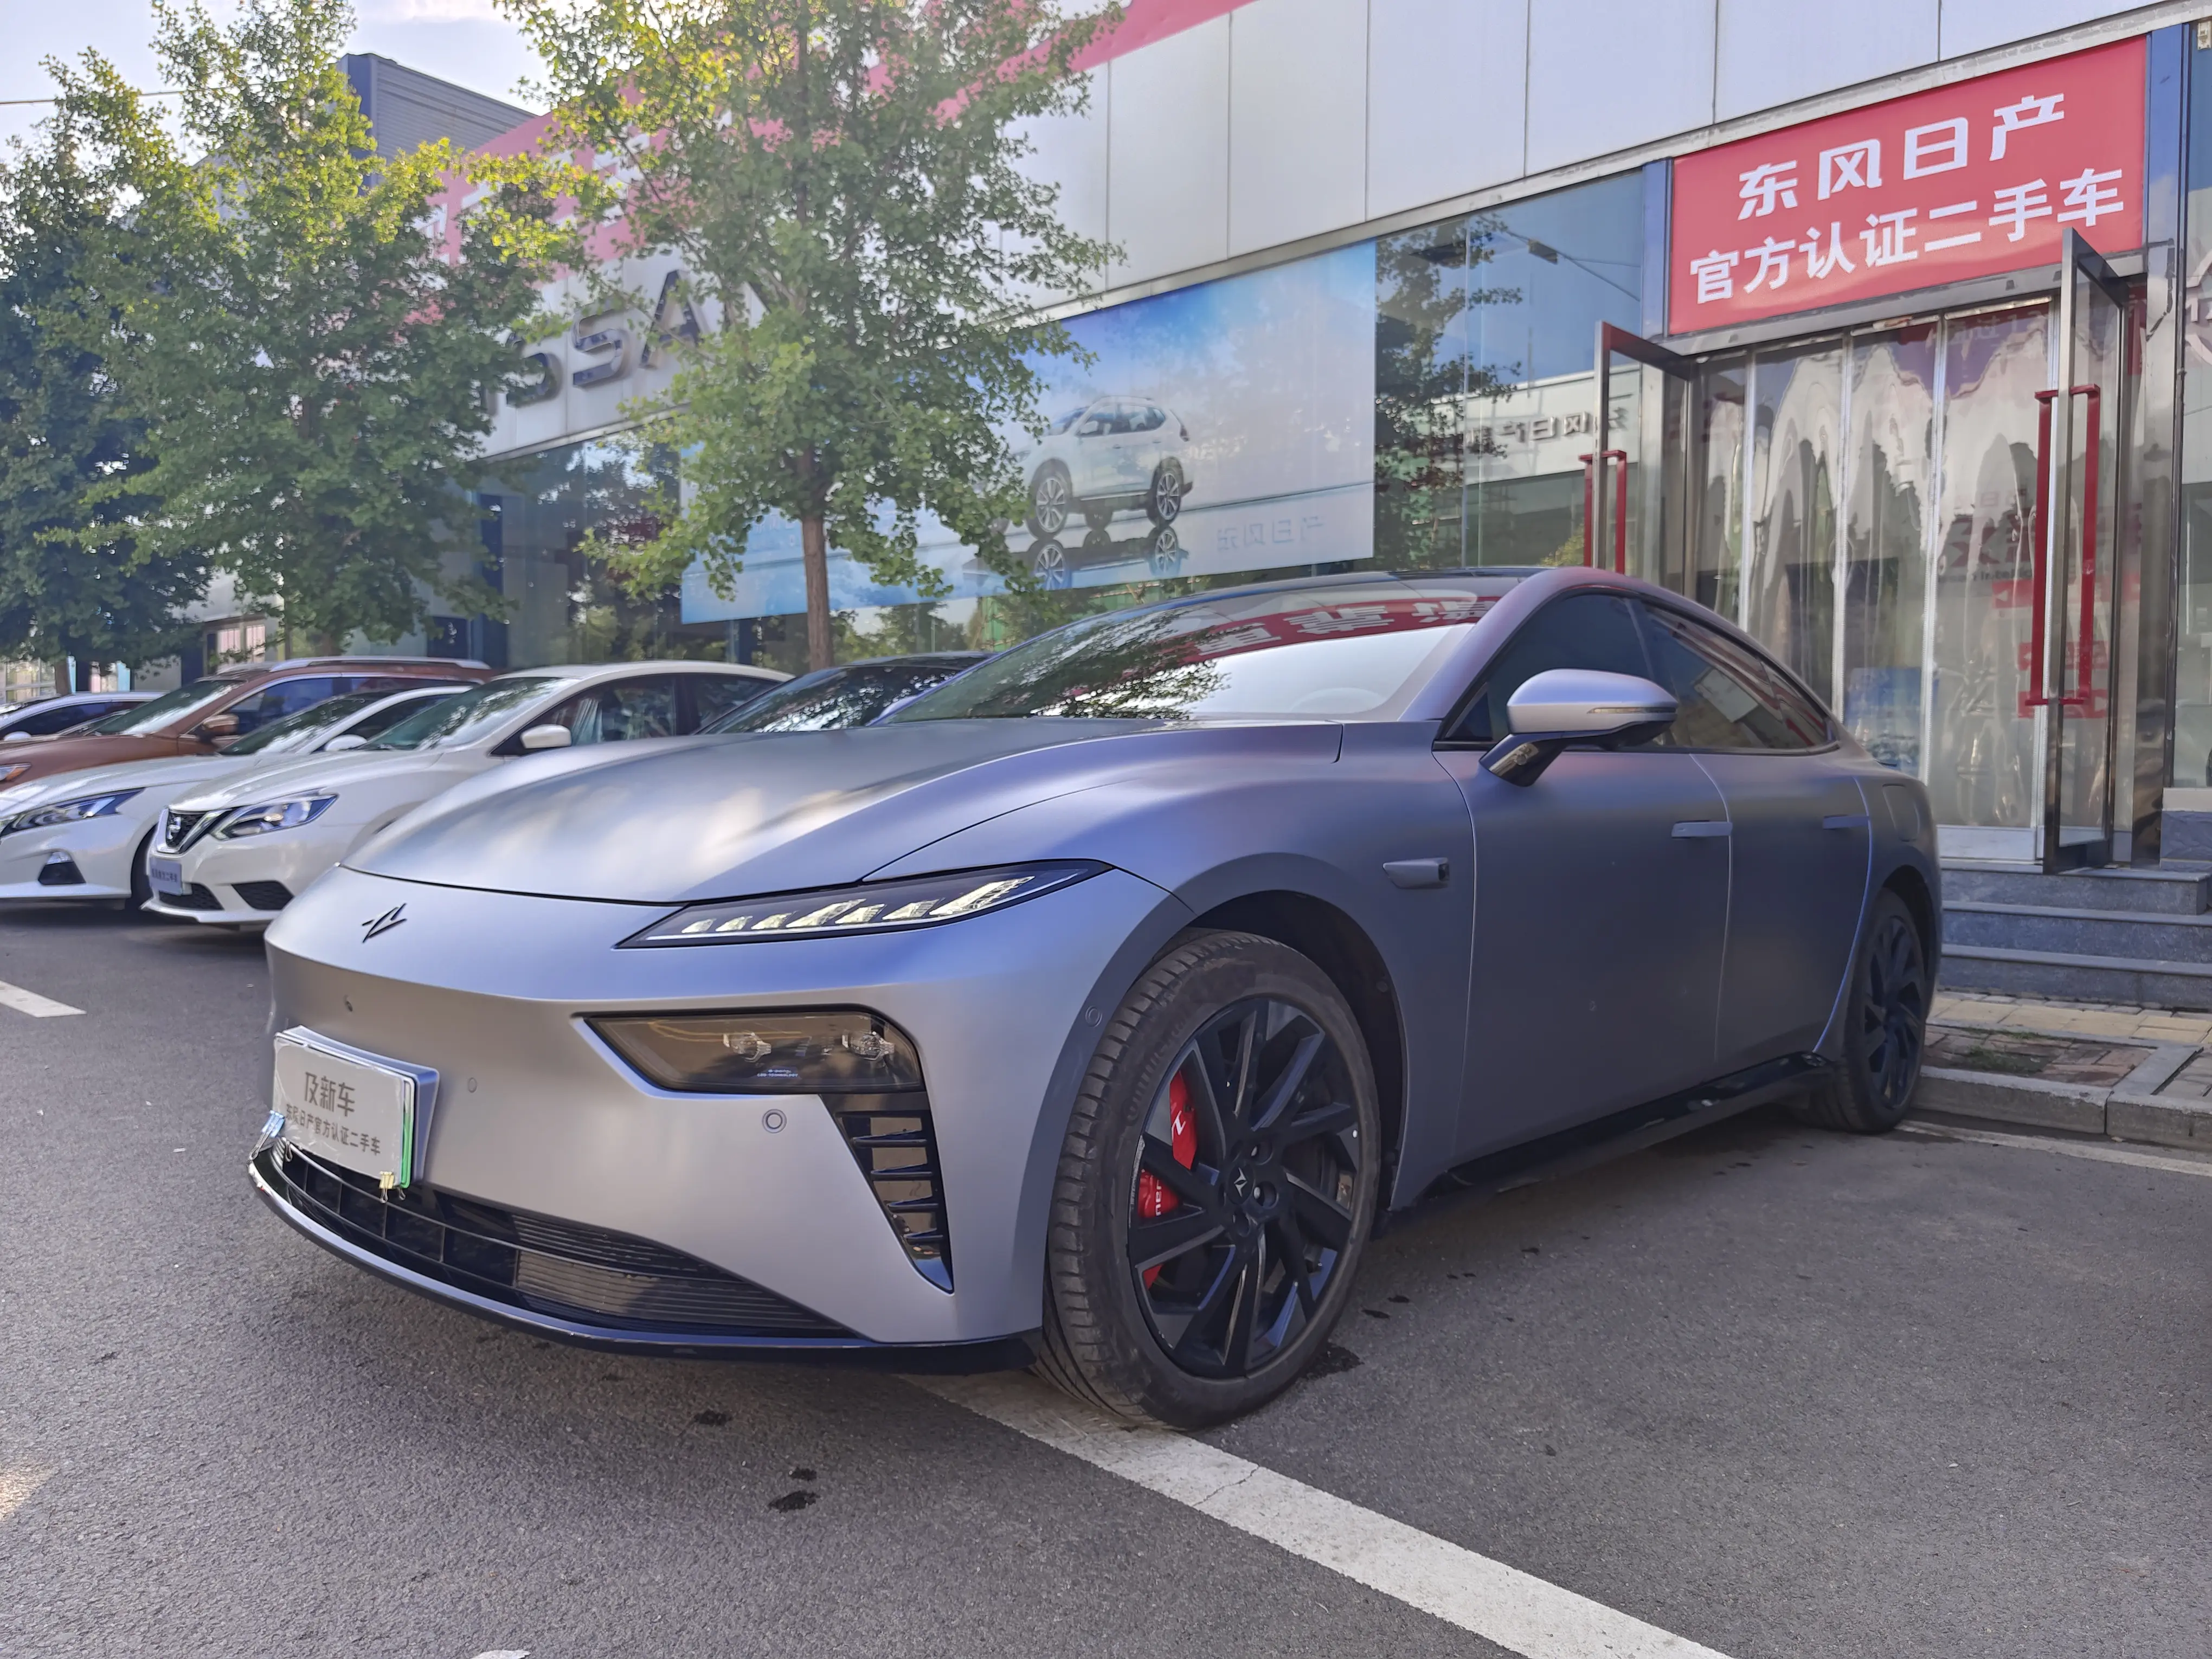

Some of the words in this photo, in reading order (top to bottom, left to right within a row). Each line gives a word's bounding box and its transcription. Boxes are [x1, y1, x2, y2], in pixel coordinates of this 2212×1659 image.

[1738, 93, 2065, 220] 东风日产
[1689, 168, 2124, 305] 官方认证二手车
[304, 1071, 356, 1117] 及新车
